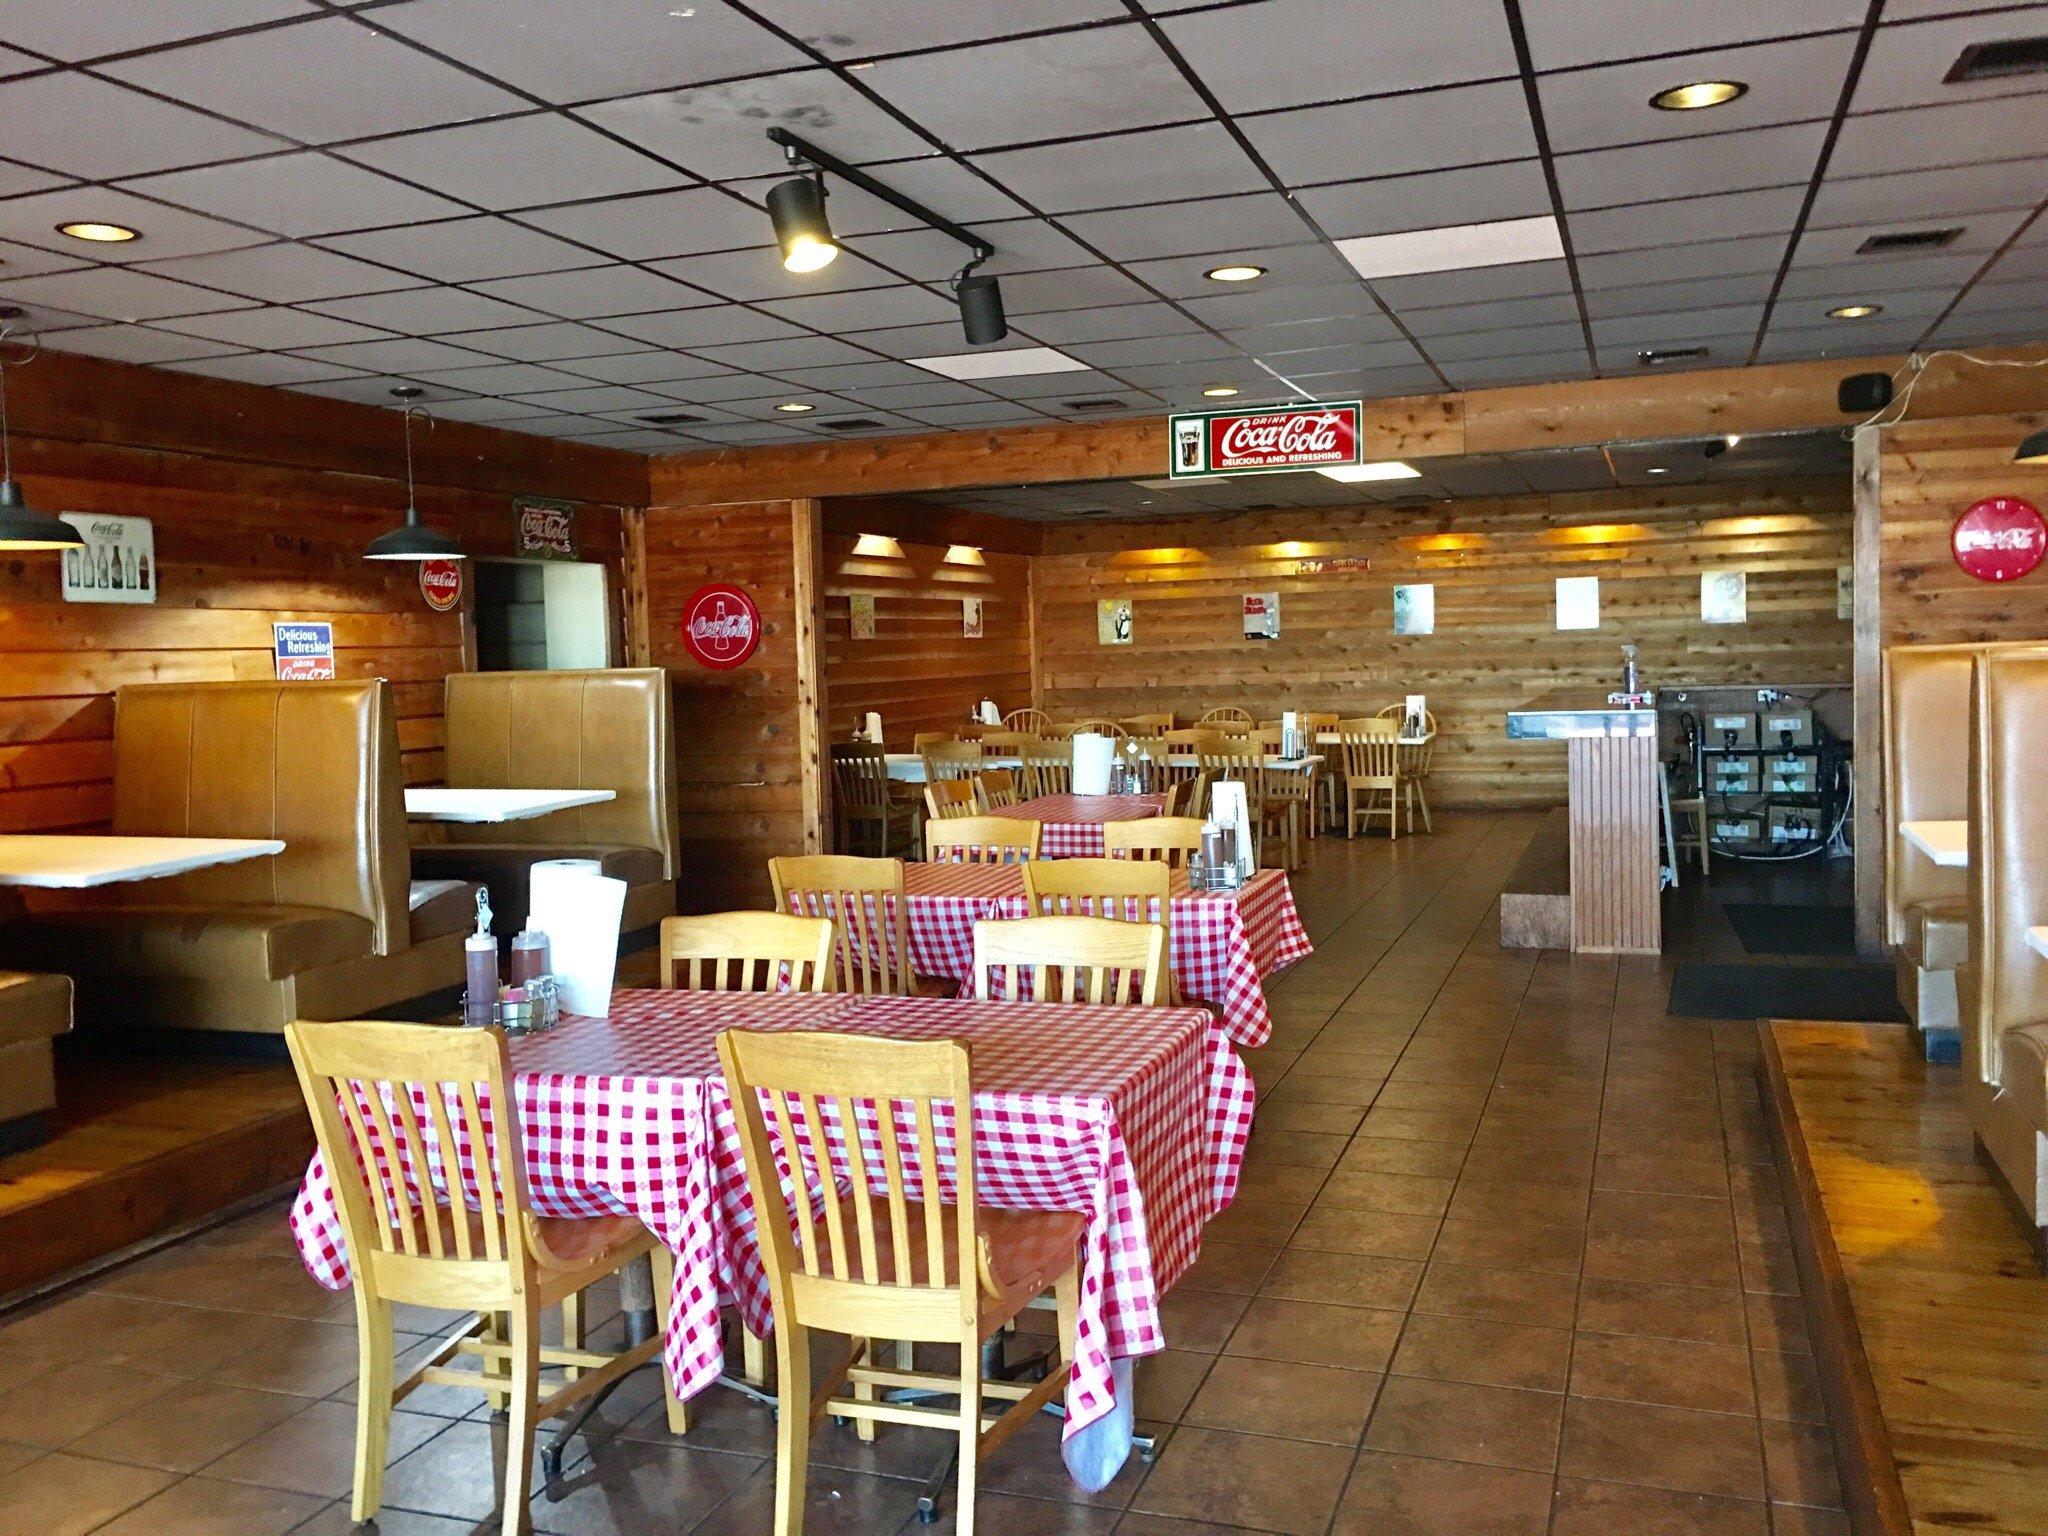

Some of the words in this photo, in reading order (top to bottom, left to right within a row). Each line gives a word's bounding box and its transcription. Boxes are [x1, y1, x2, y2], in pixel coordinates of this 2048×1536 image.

[1252, 416, 1288, 426] DRINK
[1221, 413, 1341, 458] Coca-Cola
[1222, 456, 1264, 467] DELICIOUS
[1266, 454, 1287, 464] AND
[1289, 451, 1342, 463] REFRESHING
[521, 512, 570, 540] Coca-Cola
[425, 570, 458, 588] Coca-Cola
[278, 627, 318, 641] Delicious
[693, 614, 751, 639] Coca-Cola
[287, 640, 332, 655] Refreshing
